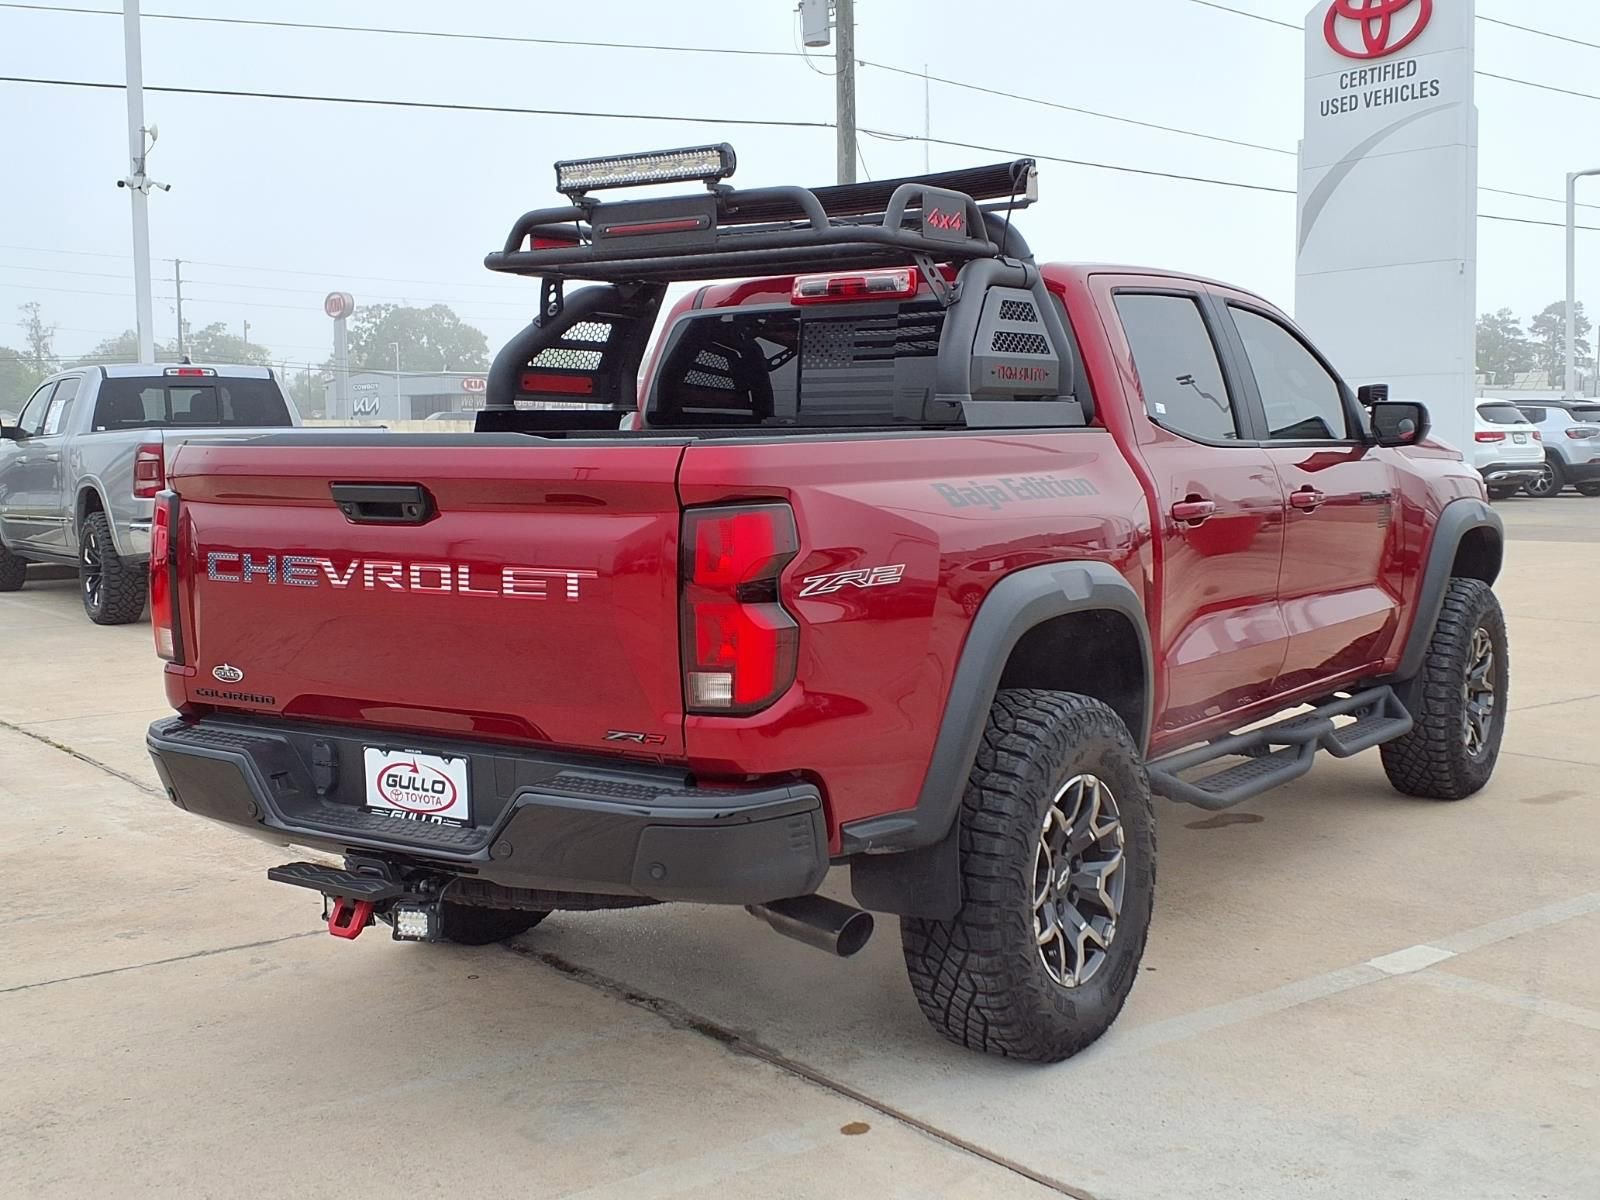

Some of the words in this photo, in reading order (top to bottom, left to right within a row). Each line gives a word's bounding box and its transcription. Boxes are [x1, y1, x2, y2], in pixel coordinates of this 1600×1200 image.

[1339, 59, 1417, 90] CERTIFIED
[1320, 94, 1358, 117] USED
[1363, 79, 1440, 109] VEHICLES
[466, 380, 485, 389] KIA
[930, 481, 1013, 511] Baja
[998, 475, 1101, 501] Edition
[207, 551, 598, 601] CHEVROLET
[799, 564, 905, 597] ZR2
[196, 687, 276, 705] COLORADO
[602, 729, 667, 745] ZR2
[386, 773, 446, 794] GULLO
[405, 792, 443, 806] TOYOTA
